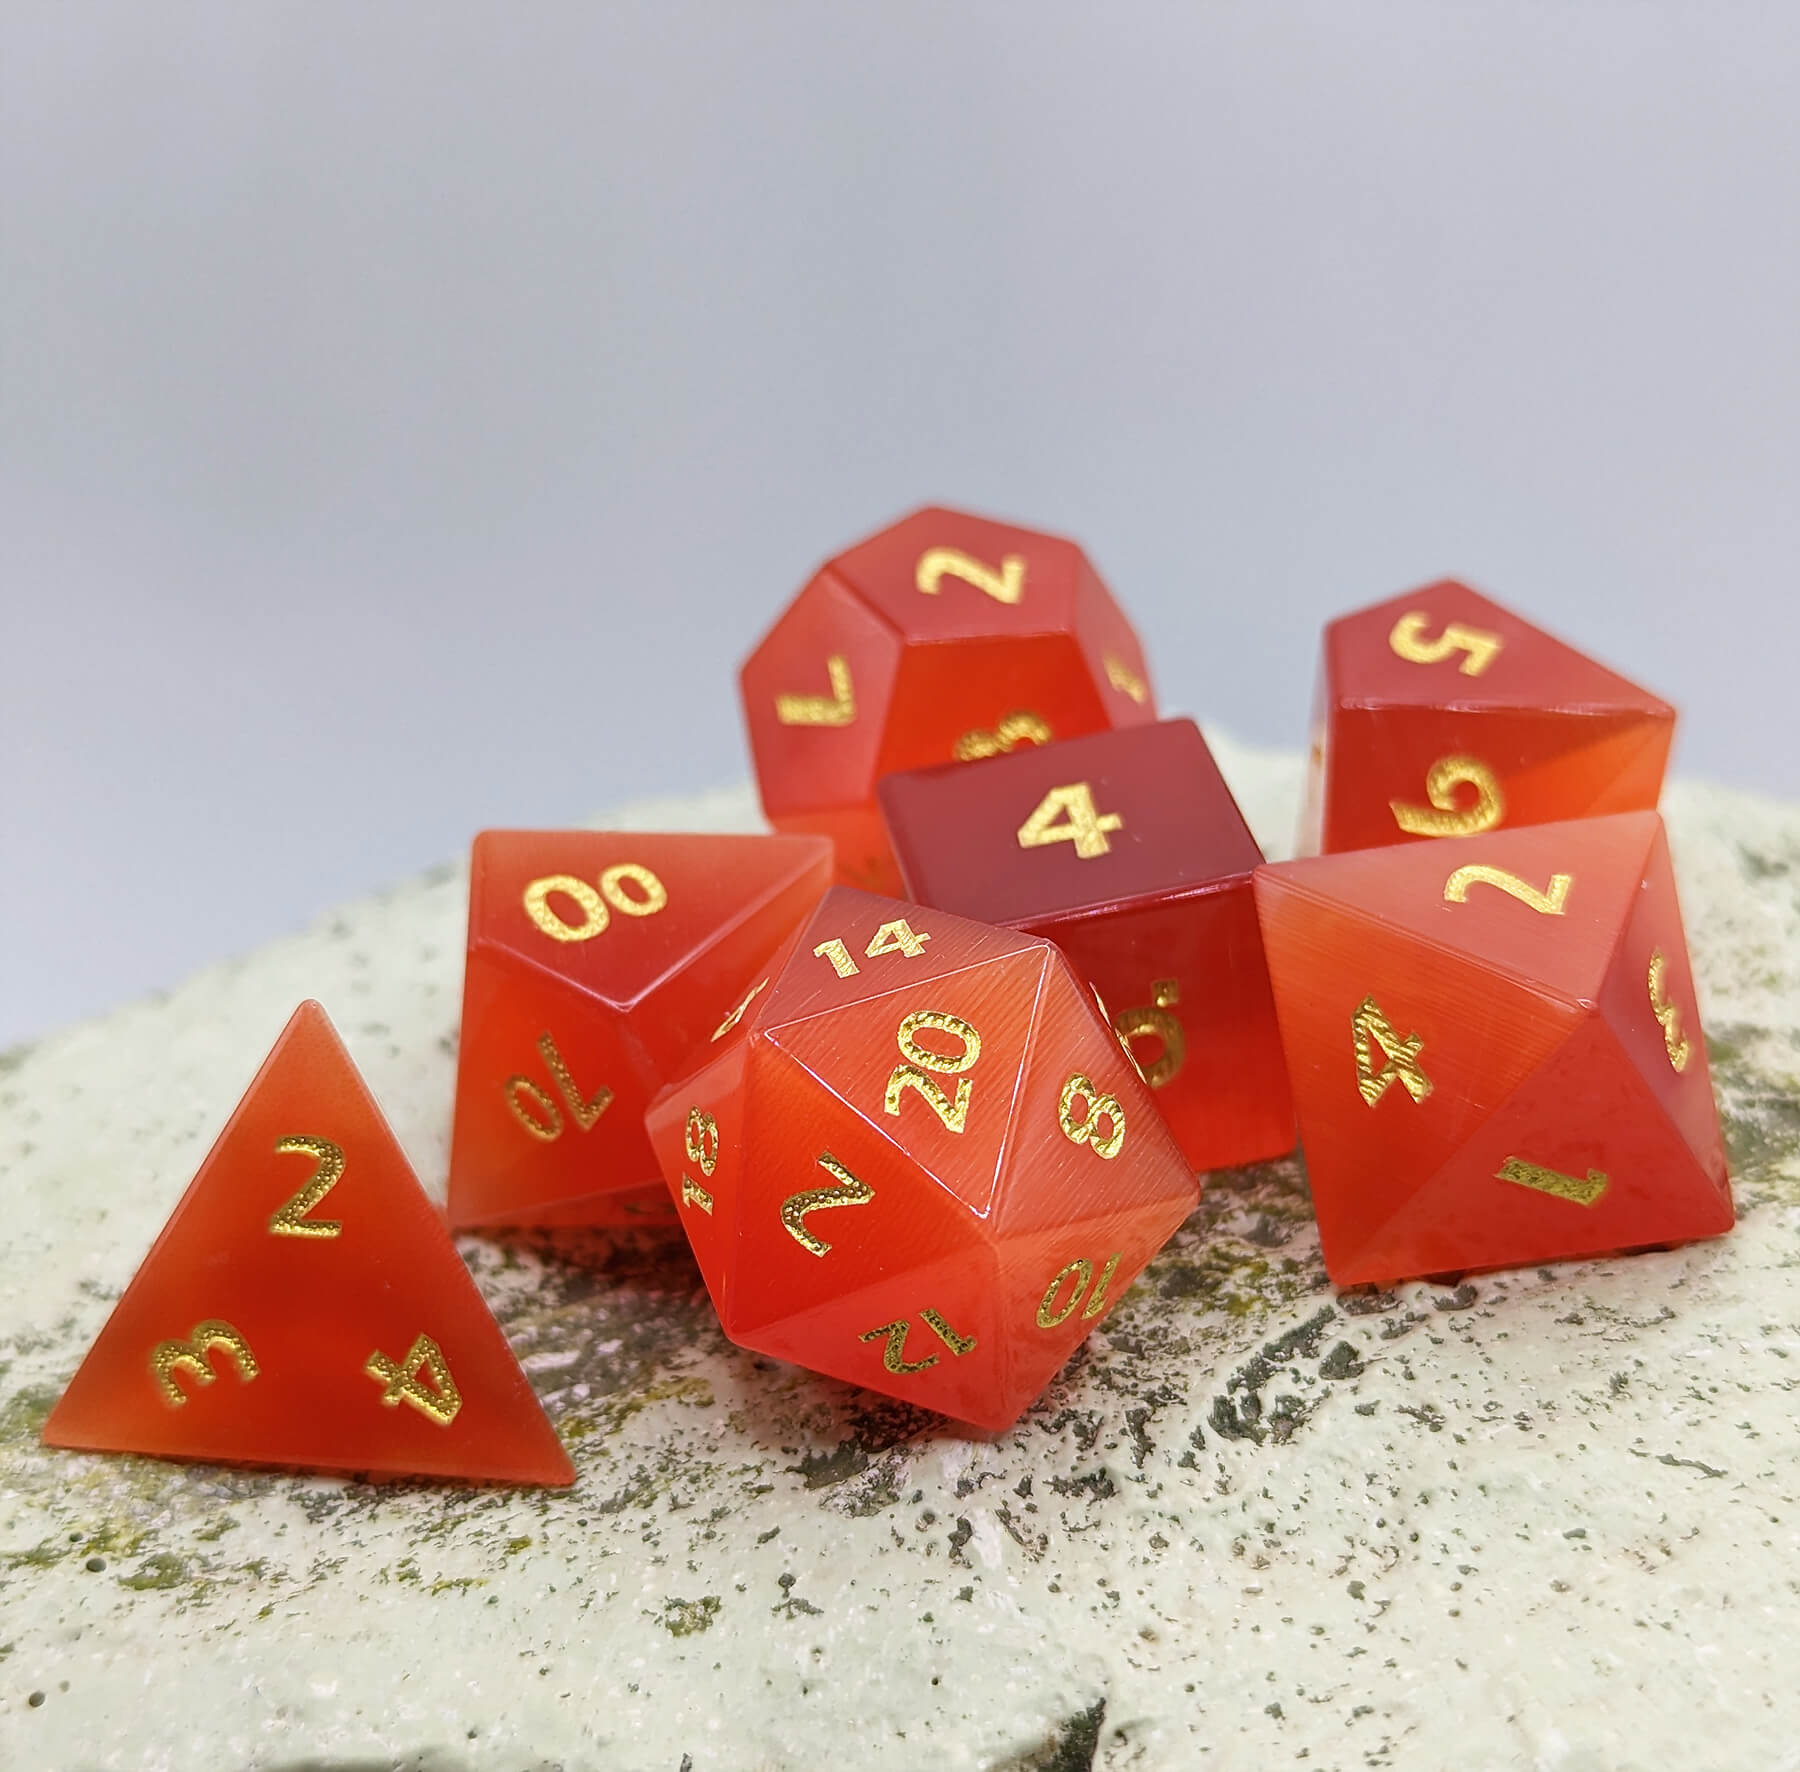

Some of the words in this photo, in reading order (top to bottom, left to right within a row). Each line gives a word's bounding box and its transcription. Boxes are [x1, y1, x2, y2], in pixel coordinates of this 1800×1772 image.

[916, 548, 1025, 604] 2
[1389, 612, 1499, 677] 5
[776, 655, 855, 726] 7
[1017, 781, 1123, 860] 4
[523, 863, 667, 942] 00
[1444, 864, 1572, 915] 2
[813, 919, 930, 978] 14
[503, 1032, 614, 1142] 70
[884, 1009, 982, 1134] 20
[1350, 995, 1433, 1107] 4
[1058, 1072, 1126, 1160] 8
[269, 1134, 346, 1239] 2
[683, 1106, 719, 1216] 18
[1493, 1156, 1608, 1205] 1
[780, 1152, 876, 1257] 2
[1037, 1253, 1122, 1329] 10
[150, 1320, 260, 1407] 3
[365, 1332, 463, 1426] 4
[858, 1308, 978, 1375] 12
